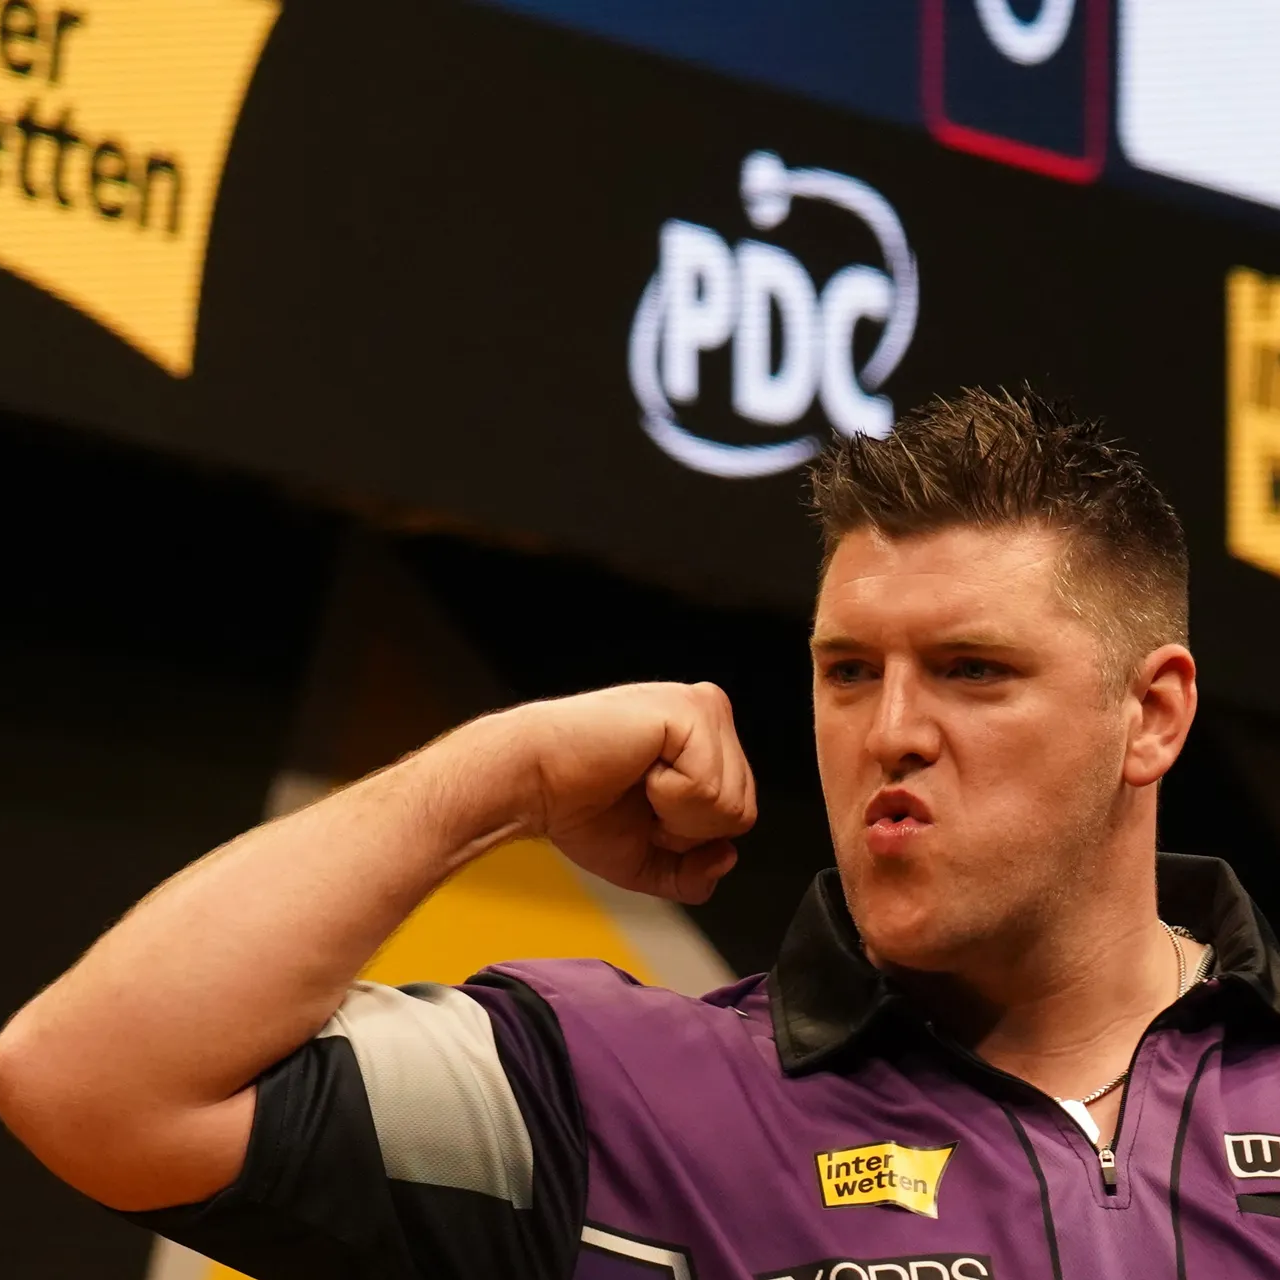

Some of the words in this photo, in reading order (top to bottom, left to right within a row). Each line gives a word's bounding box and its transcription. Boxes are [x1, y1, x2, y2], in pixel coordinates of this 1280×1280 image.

[660, 217, 895, 440] PDC
[826, 1152, 894, 1180] inter
[834, 1169, 928, 1198] wetten
